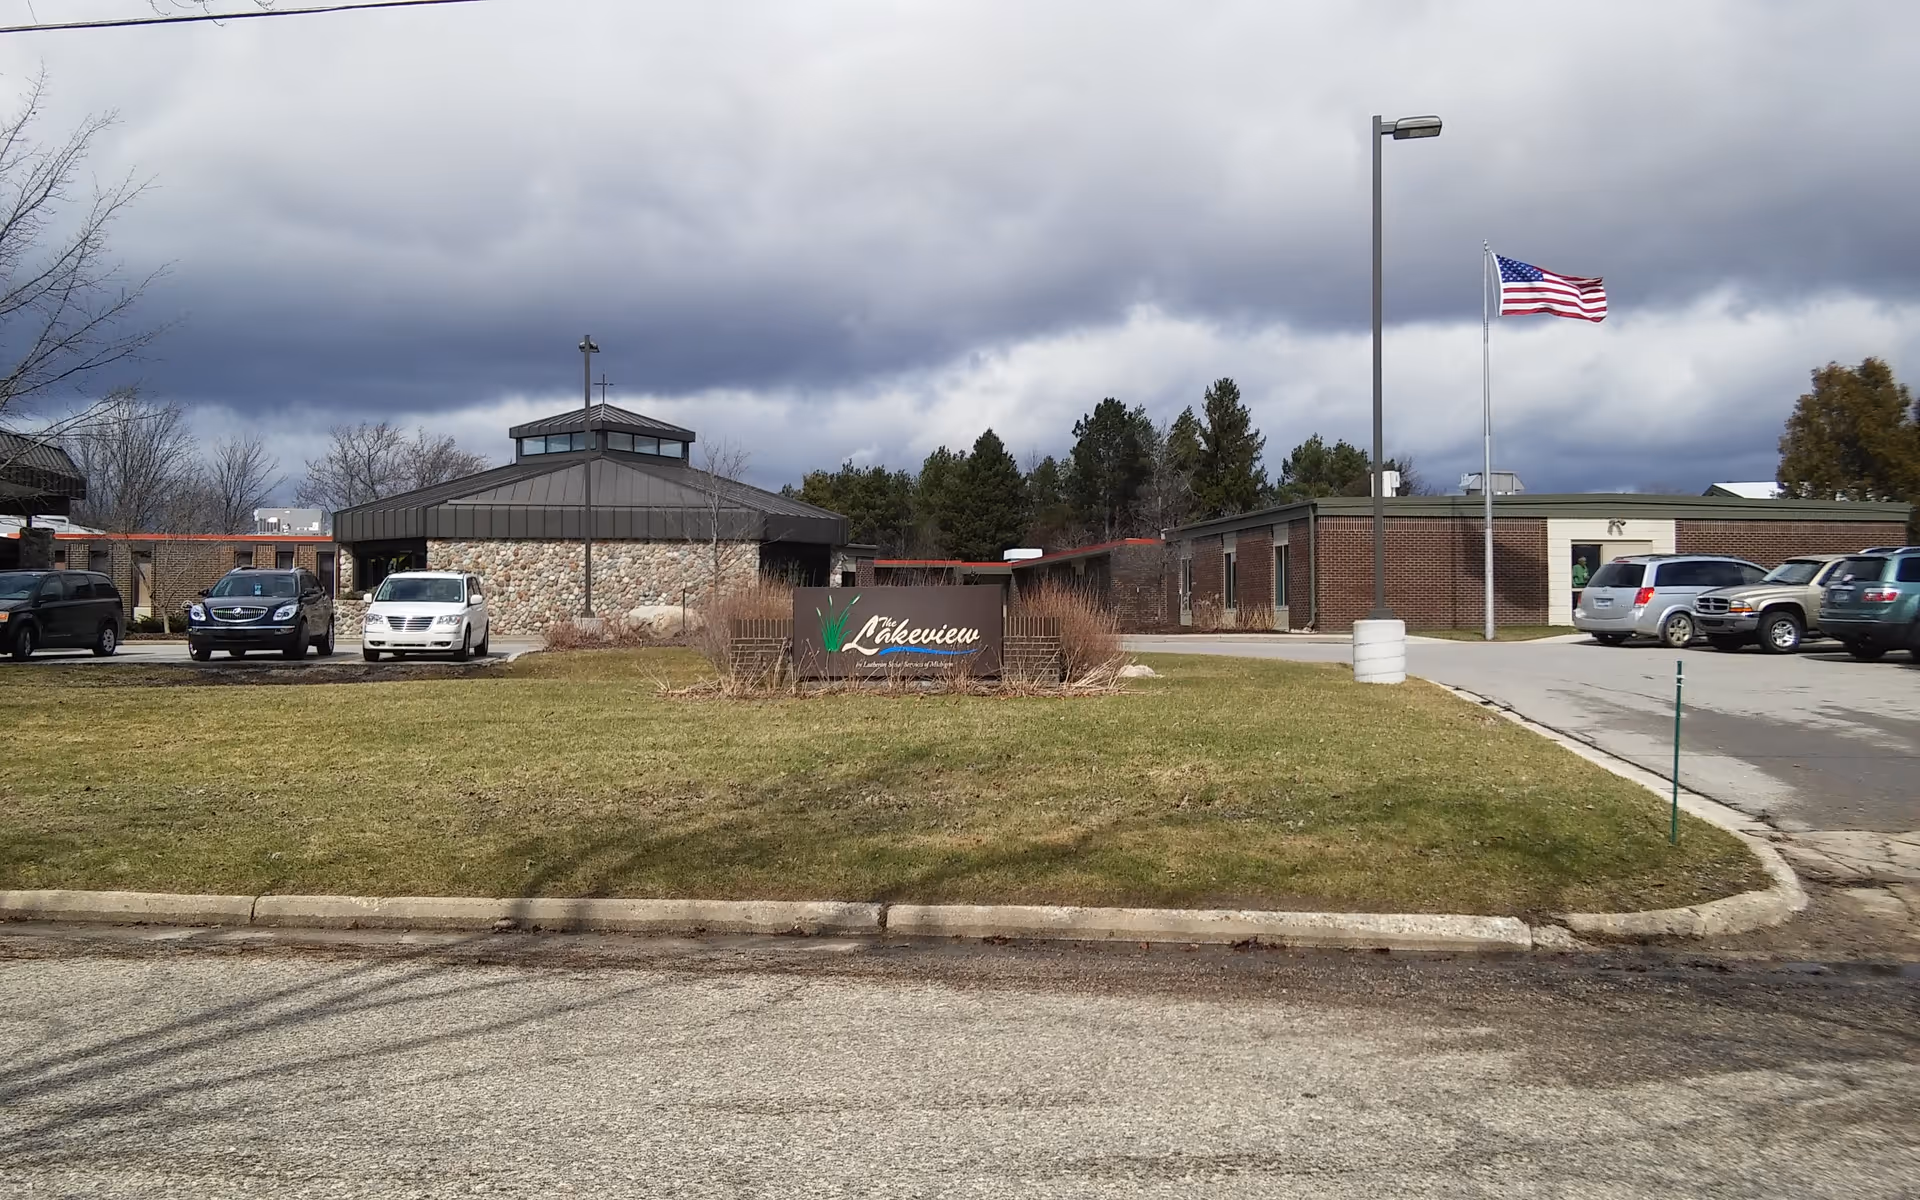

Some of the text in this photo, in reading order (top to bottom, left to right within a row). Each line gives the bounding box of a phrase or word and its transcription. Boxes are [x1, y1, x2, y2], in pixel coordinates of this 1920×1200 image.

[878, 616, 897, 628] The
[841, 614, 980, 656] Lakeview
[924, 661, 931, 669] of
